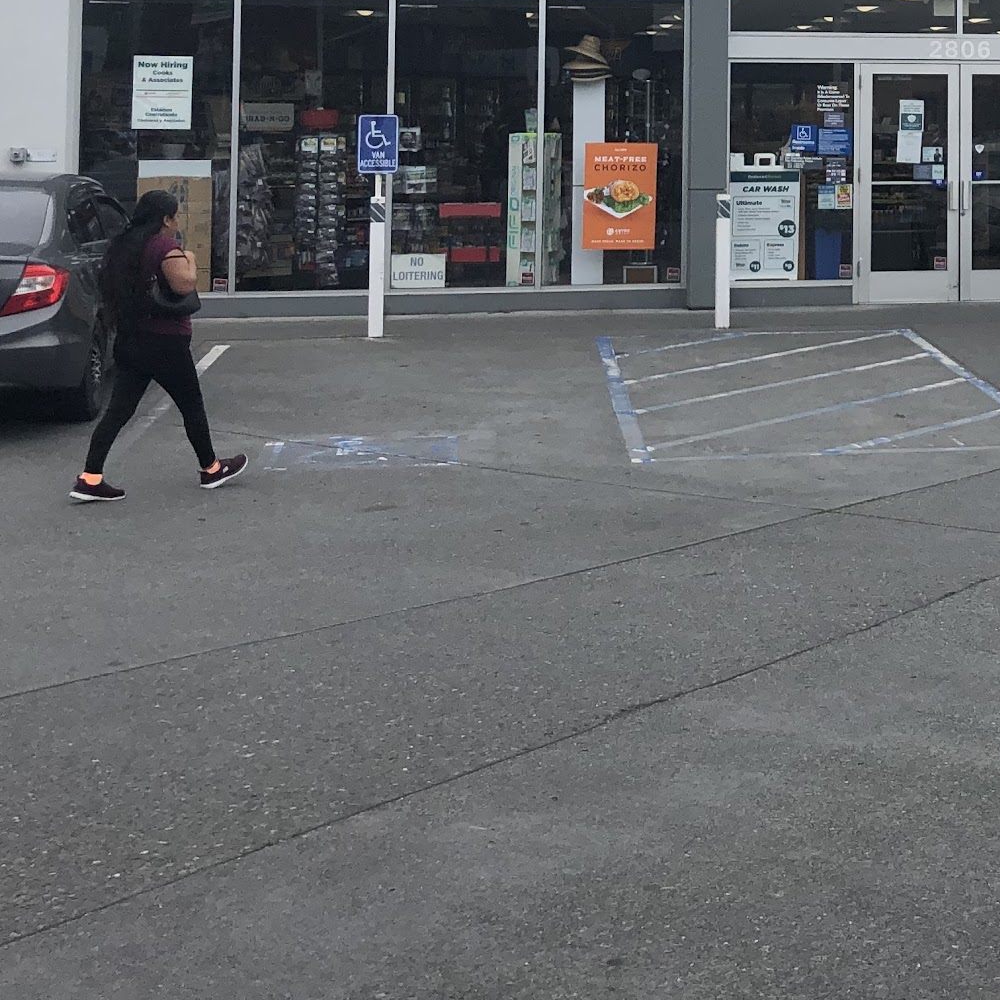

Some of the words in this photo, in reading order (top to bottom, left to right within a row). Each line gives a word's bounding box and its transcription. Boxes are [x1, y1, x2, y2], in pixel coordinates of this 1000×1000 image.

[929, 40, 991, 59] 2806
[160, 61, 188, 70] Hiring
[360, 159, 396, 168] ACCESSIBLE
[780, 225, 795, 234] $13
[410, 257, 424, 266] NO
[393, 271, 444, 280] LOITERING
